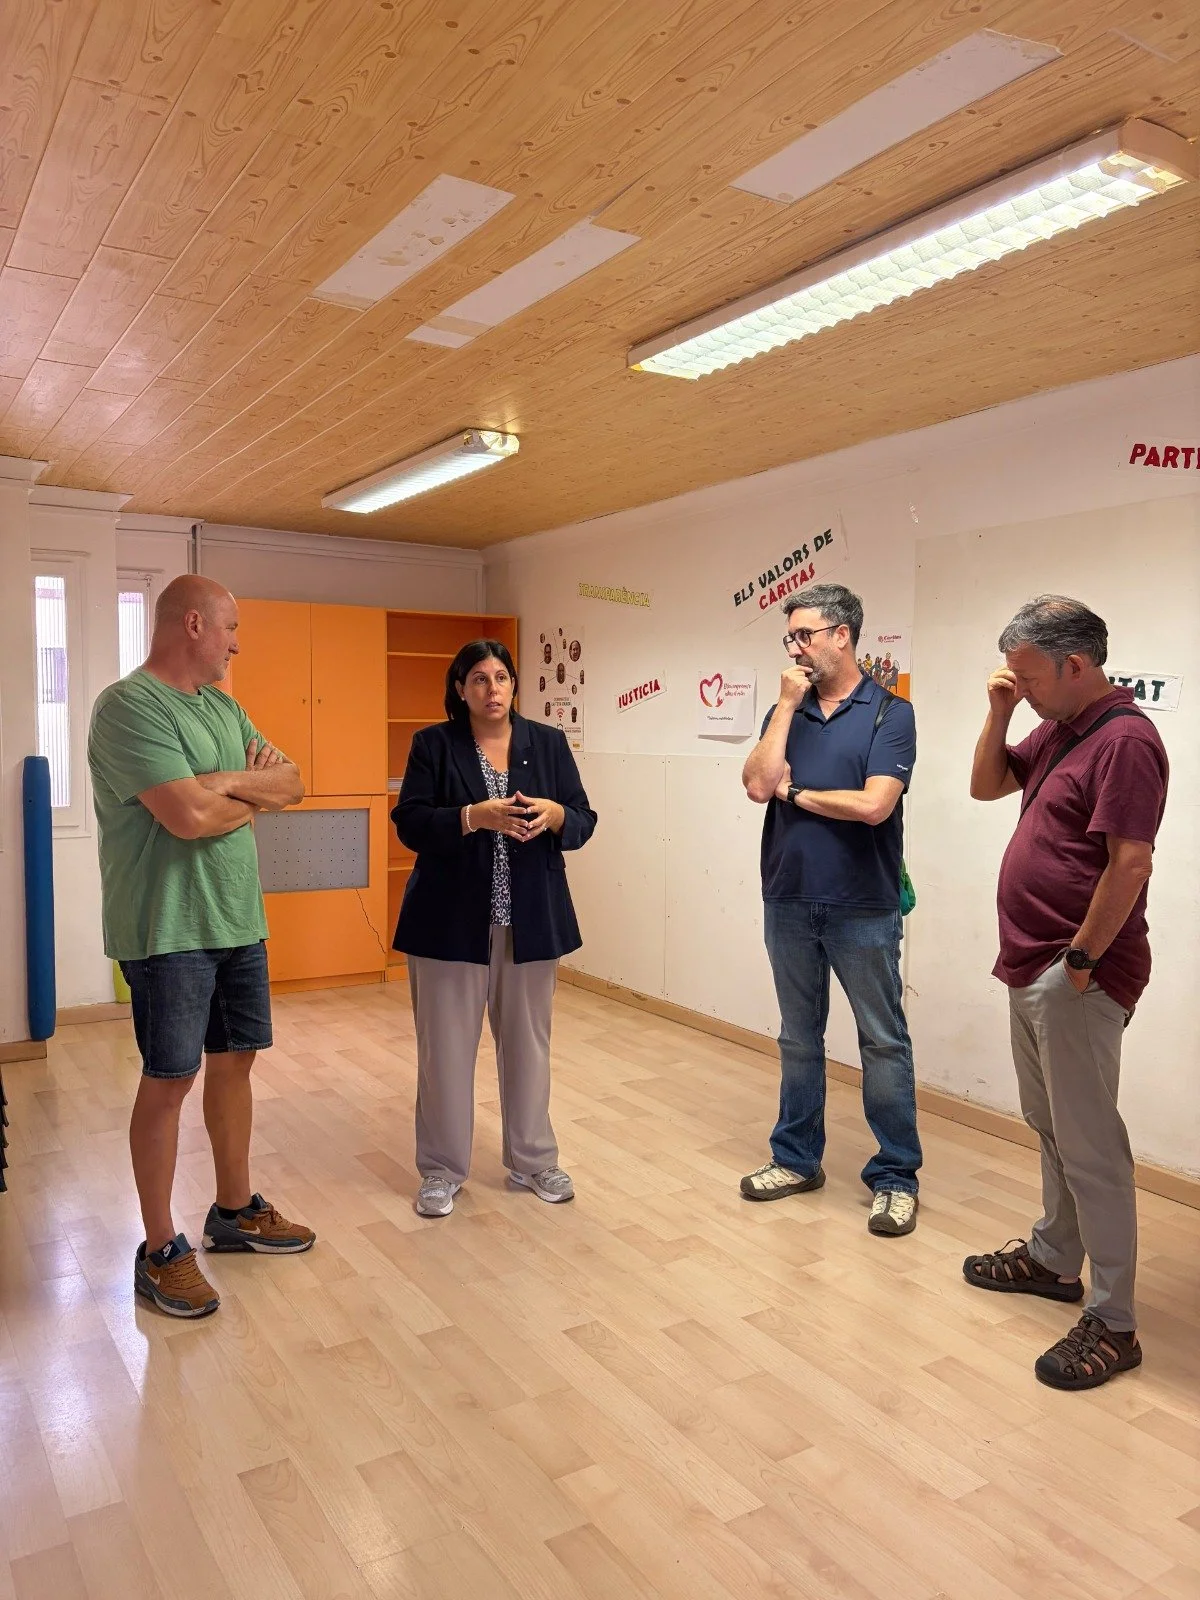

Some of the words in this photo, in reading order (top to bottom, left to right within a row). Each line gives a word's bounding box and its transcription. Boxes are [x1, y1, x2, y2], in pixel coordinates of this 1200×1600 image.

[733, 581, 755, 607] ELS
[757, 543, 810, 589] VALORS
[813, 528, 834, 552] DE
